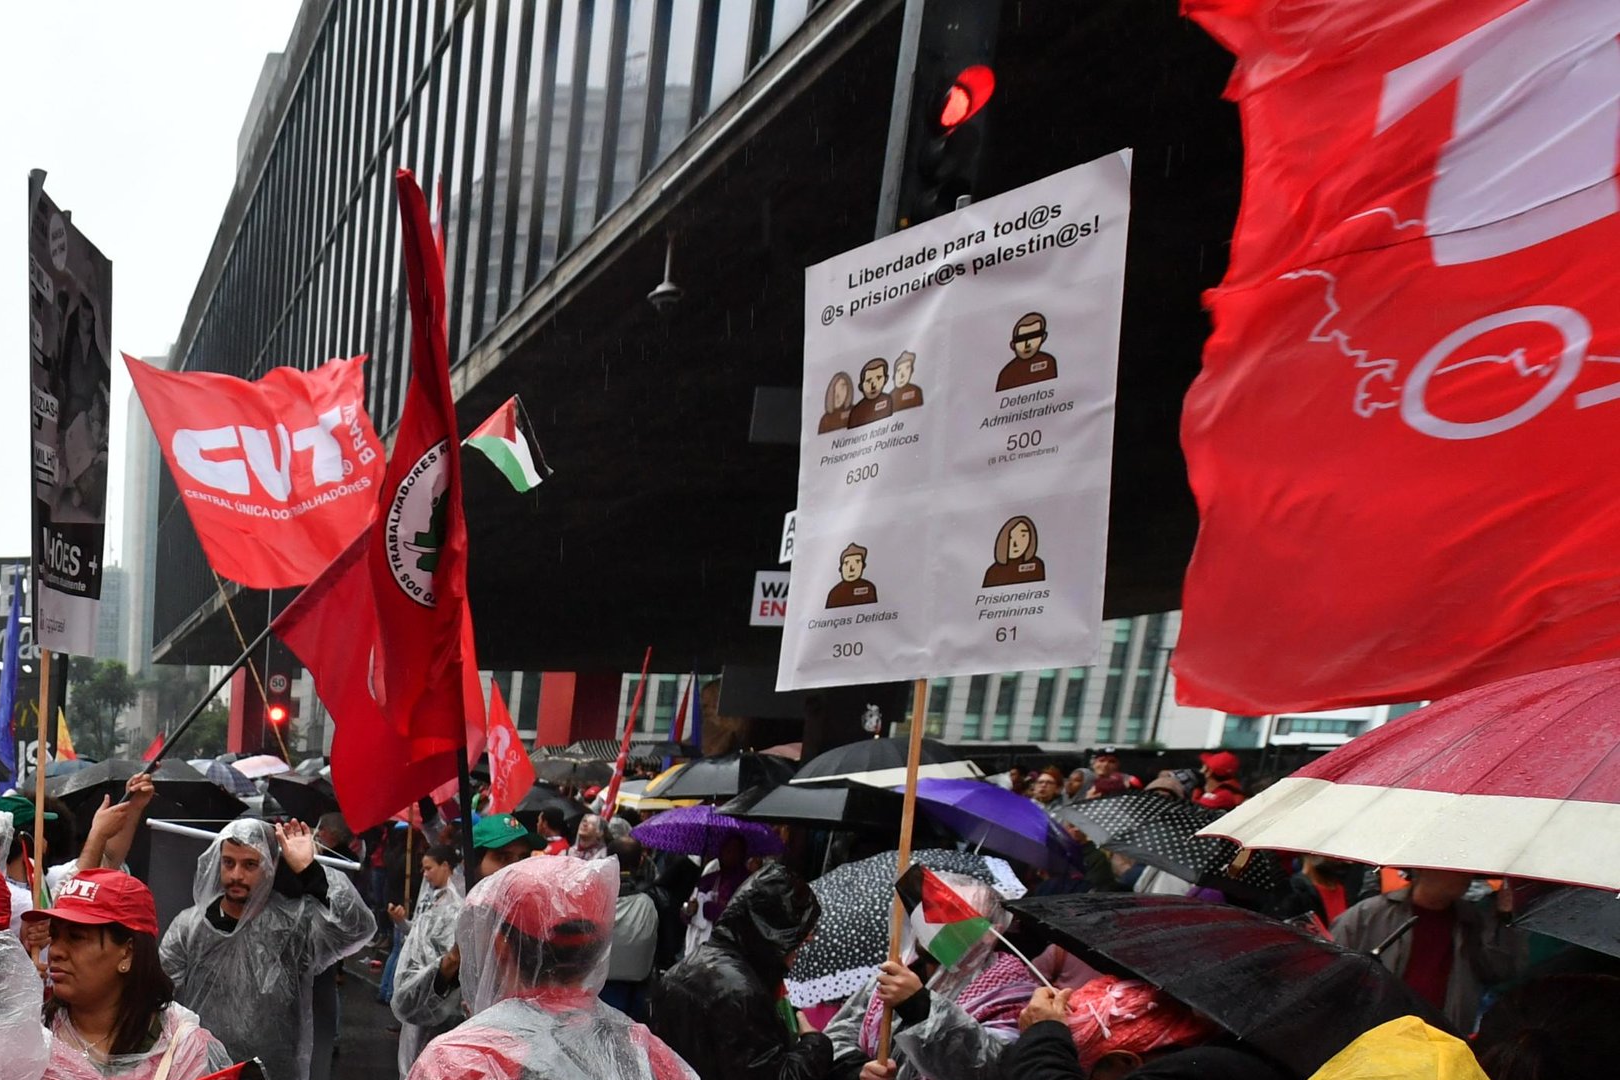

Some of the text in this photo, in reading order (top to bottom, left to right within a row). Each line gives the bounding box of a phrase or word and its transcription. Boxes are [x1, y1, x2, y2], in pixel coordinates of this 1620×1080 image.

[848, 204, 1062, 289] Liberdade para tod@s
[821, 215, 1100, 326] @s prisioneir@s palestin@s!
[999, 388, 1055, 409] Detentos
[979, 401, 1074, 430] Administrativos
[831, 430, 868, 450] Número
[890, 421, 904, 432] de
[1006, 429, 1042, 451] 500
[172, 405, 343, 502] CUT
[820, 432, 920, 467] Prisioneiros Políticos
[846, 462, 879, 485] 6300
[184, 489, 234, 511] CENTRAL
[235, 501, 270, 517] ÚNICA
[388, 452, 438, 572] TRABALHADORES
[400, 573, 423, 596] DOS
[975, 588, 1051, 607] Prisioneiras
[808, 610, 899, 630] Crianças Detidas
[978, 603, 1045, 621] Femininas
[995, 626, 1018, 642] 61
[832, 641, 864, 658] 300
